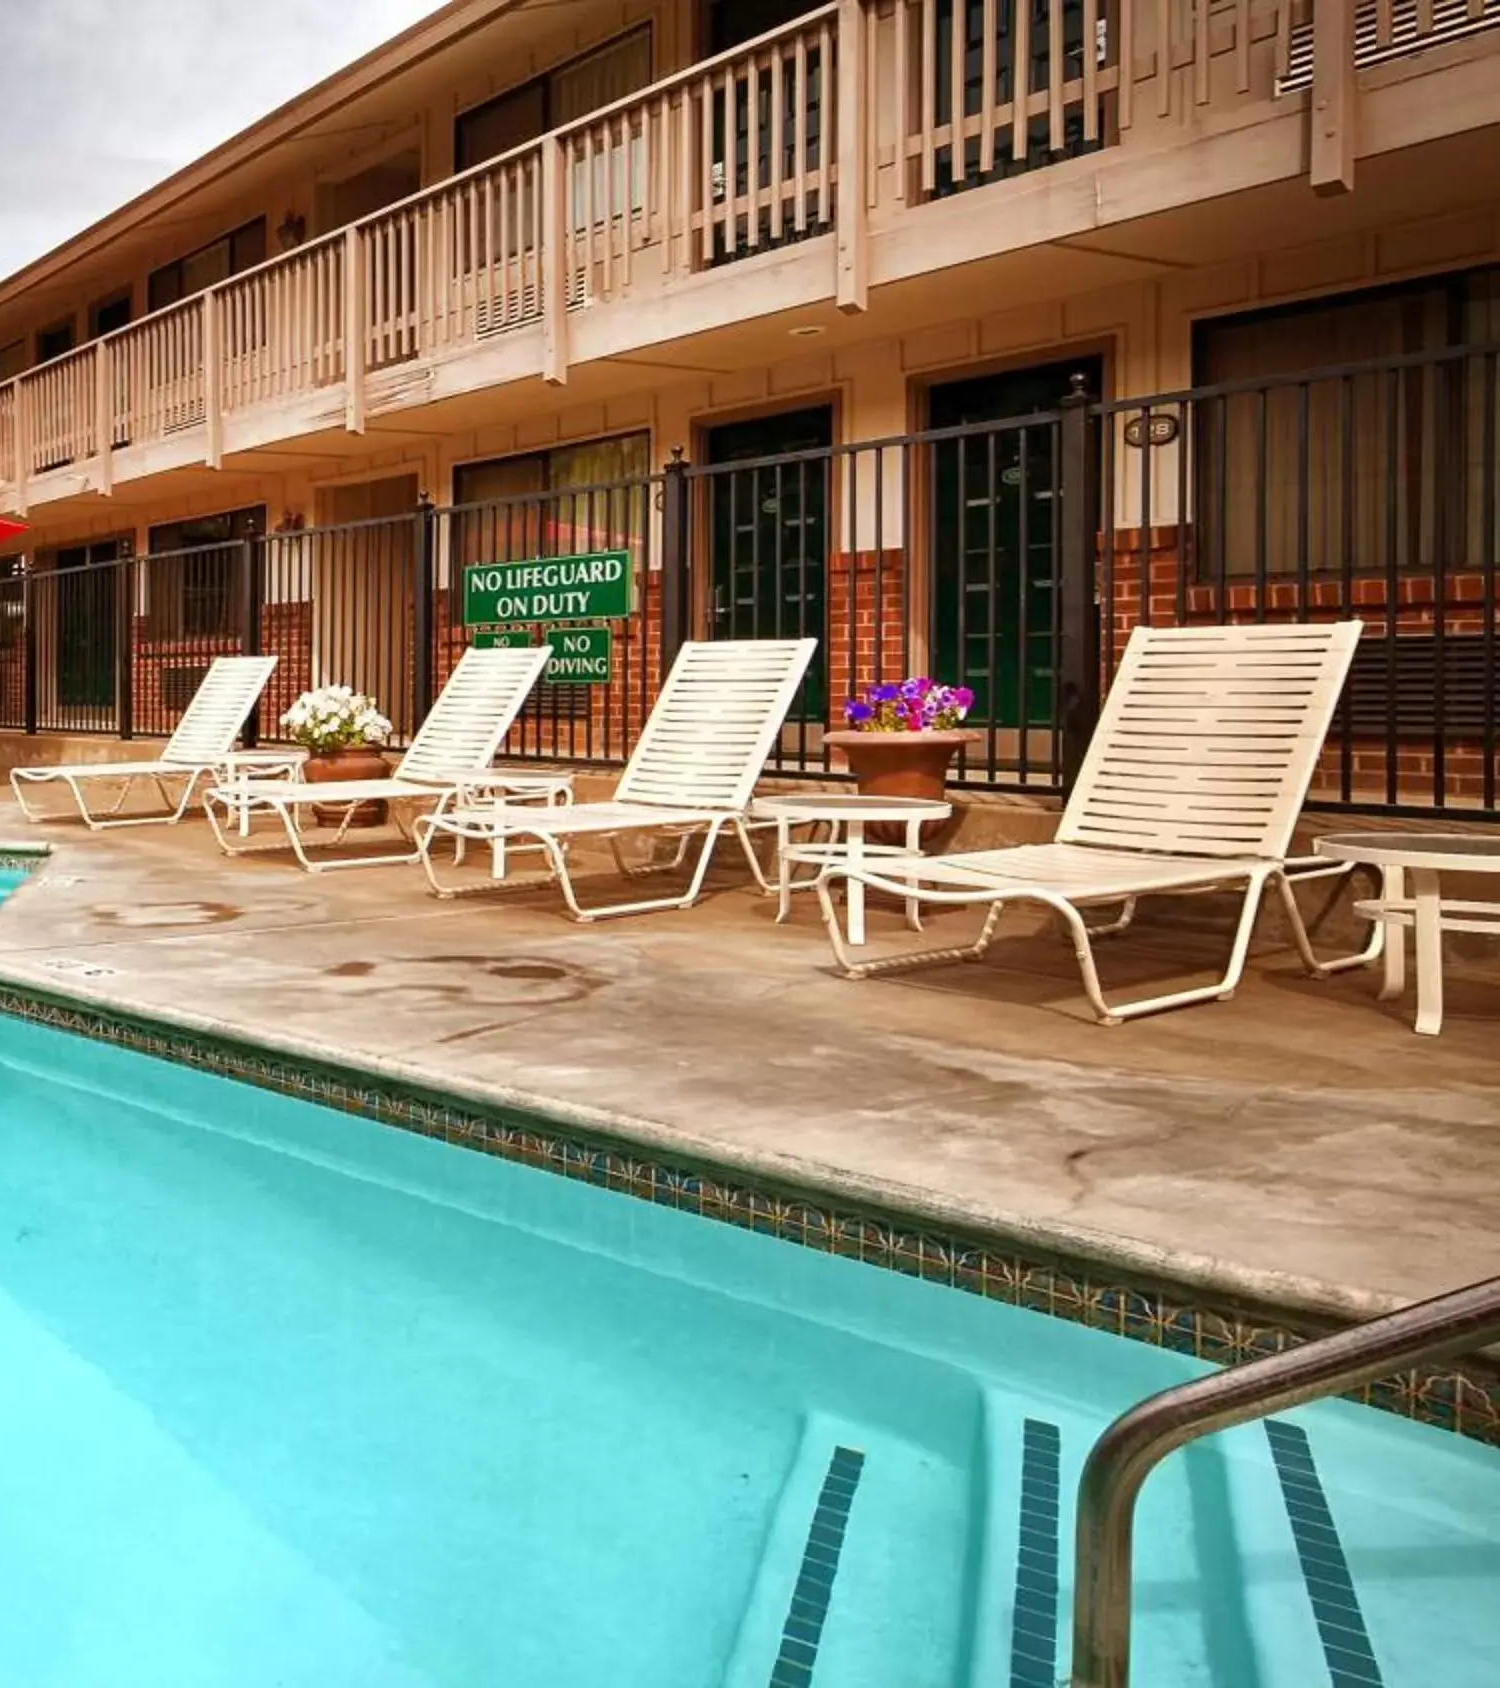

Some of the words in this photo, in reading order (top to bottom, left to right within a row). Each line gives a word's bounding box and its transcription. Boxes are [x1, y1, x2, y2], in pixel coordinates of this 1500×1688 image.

[471, 571, 502, 593] NO
[506, 559, 622, 589] LIFEGUARD
[496, 596, 528, 618] ON
[532, 591, 591, 616] DUTY
[493, 635, 510, 648] NO
[563, 635, 591, 653] NO
[547, 656, 607, 675] DIVING
